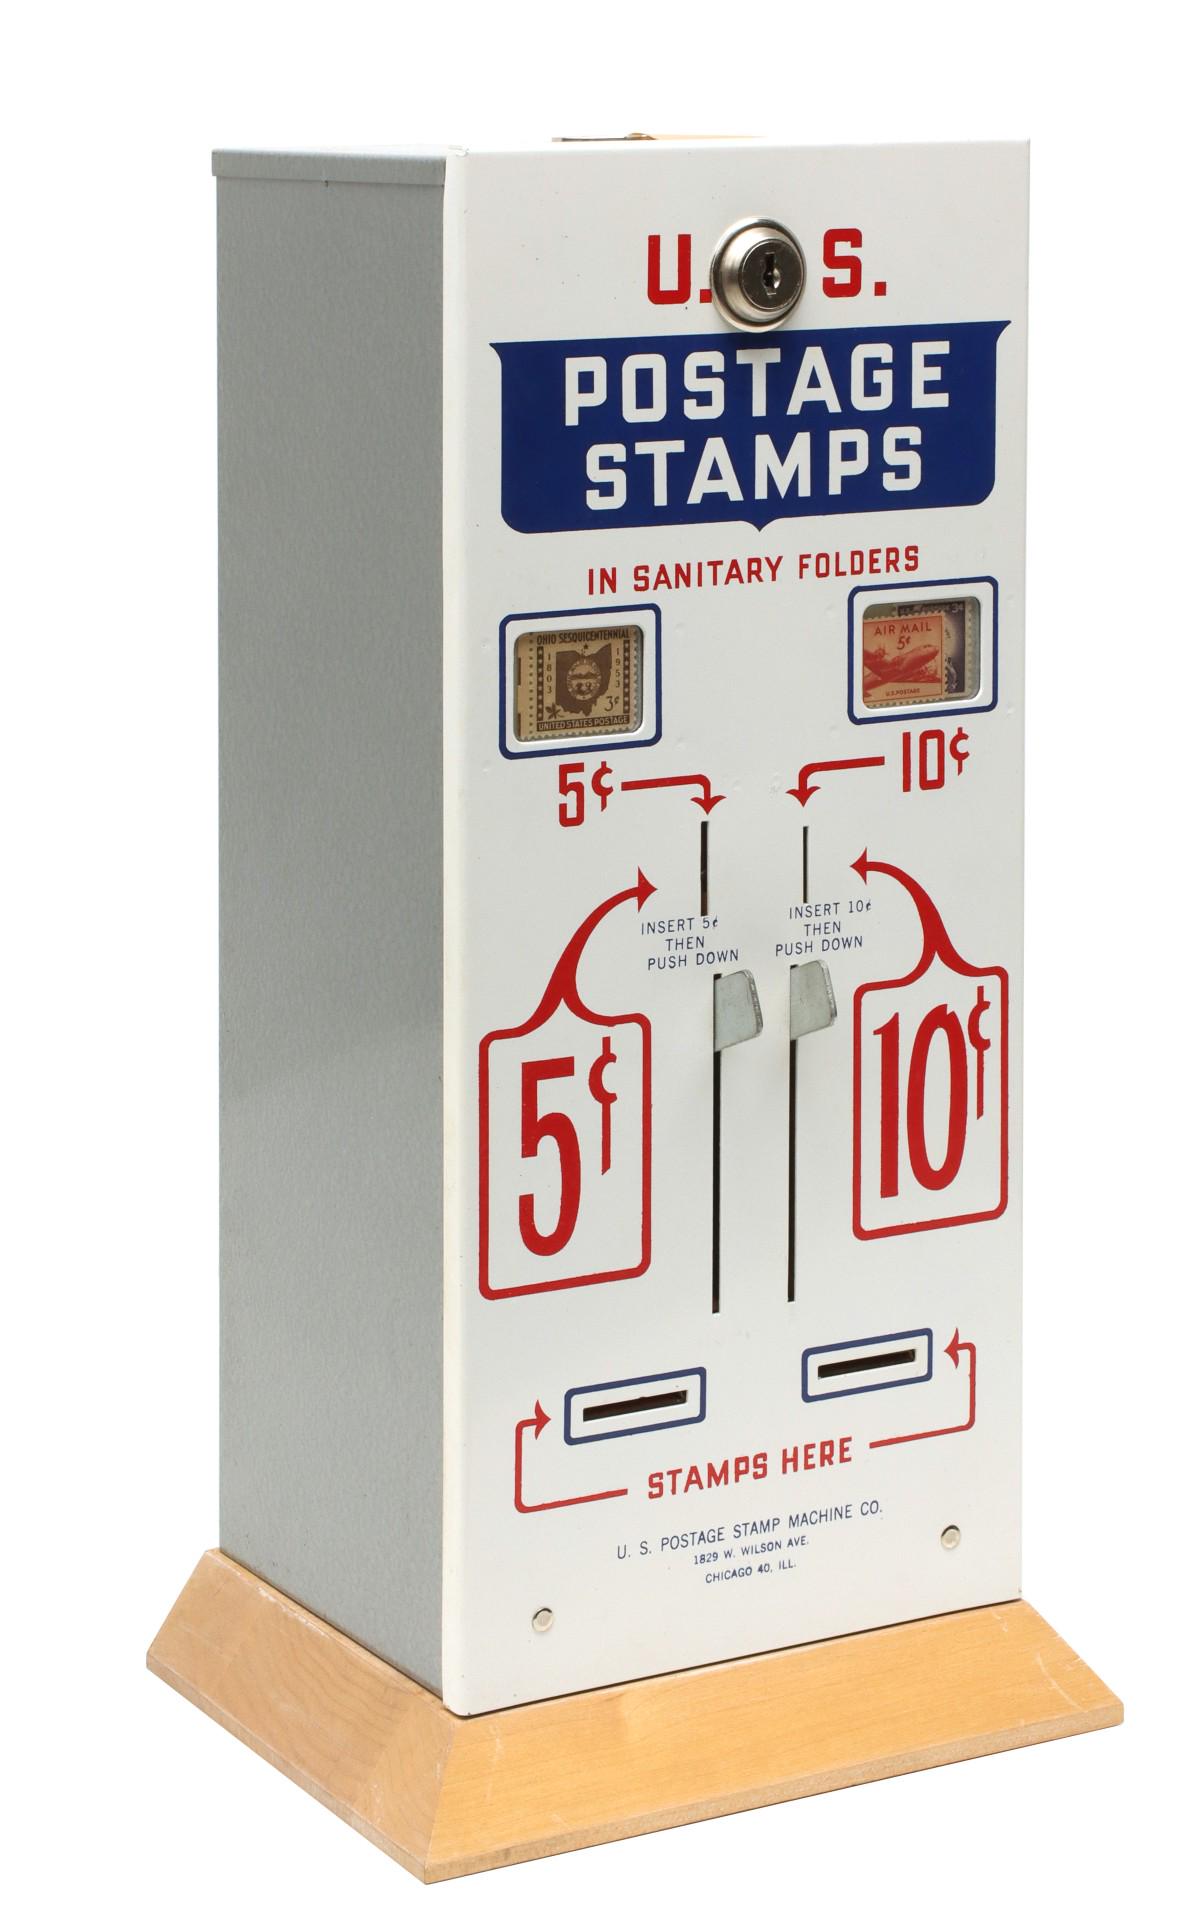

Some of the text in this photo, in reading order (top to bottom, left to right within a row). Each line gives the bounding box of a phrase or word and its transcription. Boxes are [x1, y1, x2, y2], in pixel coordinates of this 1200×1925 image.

[647, 228, 887, 304] U. S.
[564, 340, 950, 427] POSTAGE
[586, 426, 922, 511] STAMPS
[588, 545, 920, 595] IN SANITARY FOLDERS
[536, 628, 630, 646] OHIO SESQUICENTENNIAL
[874, 625, 896, 636] AIR
[901, 622, 932, 633] MAIL
[604, 696, 620, 712] 3¢
[538, 716, 628, 730] UNITED STATES POSTAGE
[902, 727, 970, 792] 10¢
[558, 761, 614, 827] 5¢
[789, 899, 872, 920] INSERT 10¢
[641, 917, 693, 935] INSERT
[804, 921, 841, 936] THEN
[666, 935, 705, 951] THEN
[775, 935, 863, 957] PUSH DOWN
[648, 949, 739, 971] PUSH DOWN
[873, 985, 991, 1199] 10¢
[519, 1036, 617, 1257] 5¢
[648, 1436, 852, 1499] STAMPS HERE
[617, 1500, 883, 1559] U. S. POSTAGE STAMP MACHINE CO.
[693, 1535, 809, 1565] 1829 W. WILSON AVE.
[705, 1566, 753, 1584] CHICAGO
[778, 1559, 797, 1571] ILL.
